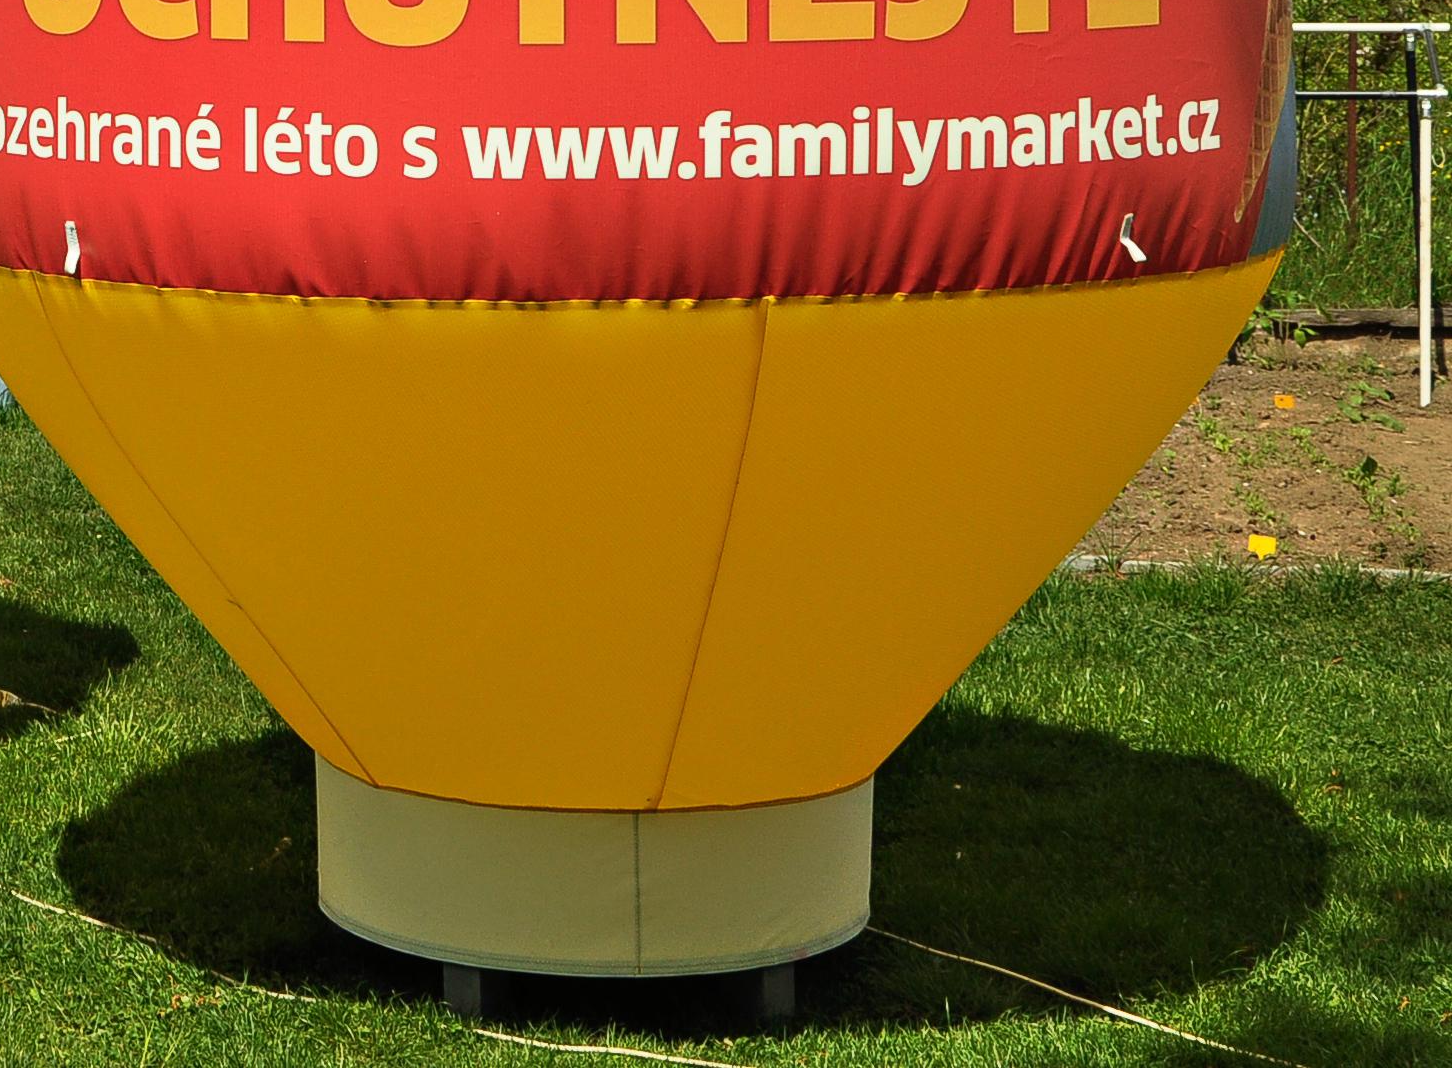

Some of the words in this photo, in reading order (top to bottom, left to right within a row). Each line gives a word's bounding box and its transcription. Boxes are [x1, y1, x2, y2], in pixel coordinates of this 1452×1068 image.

[244, 106, 379, 178] léto
[403, 124, 438, 180] s
[462, 94, 1221, 187] www.familymarket.cz
